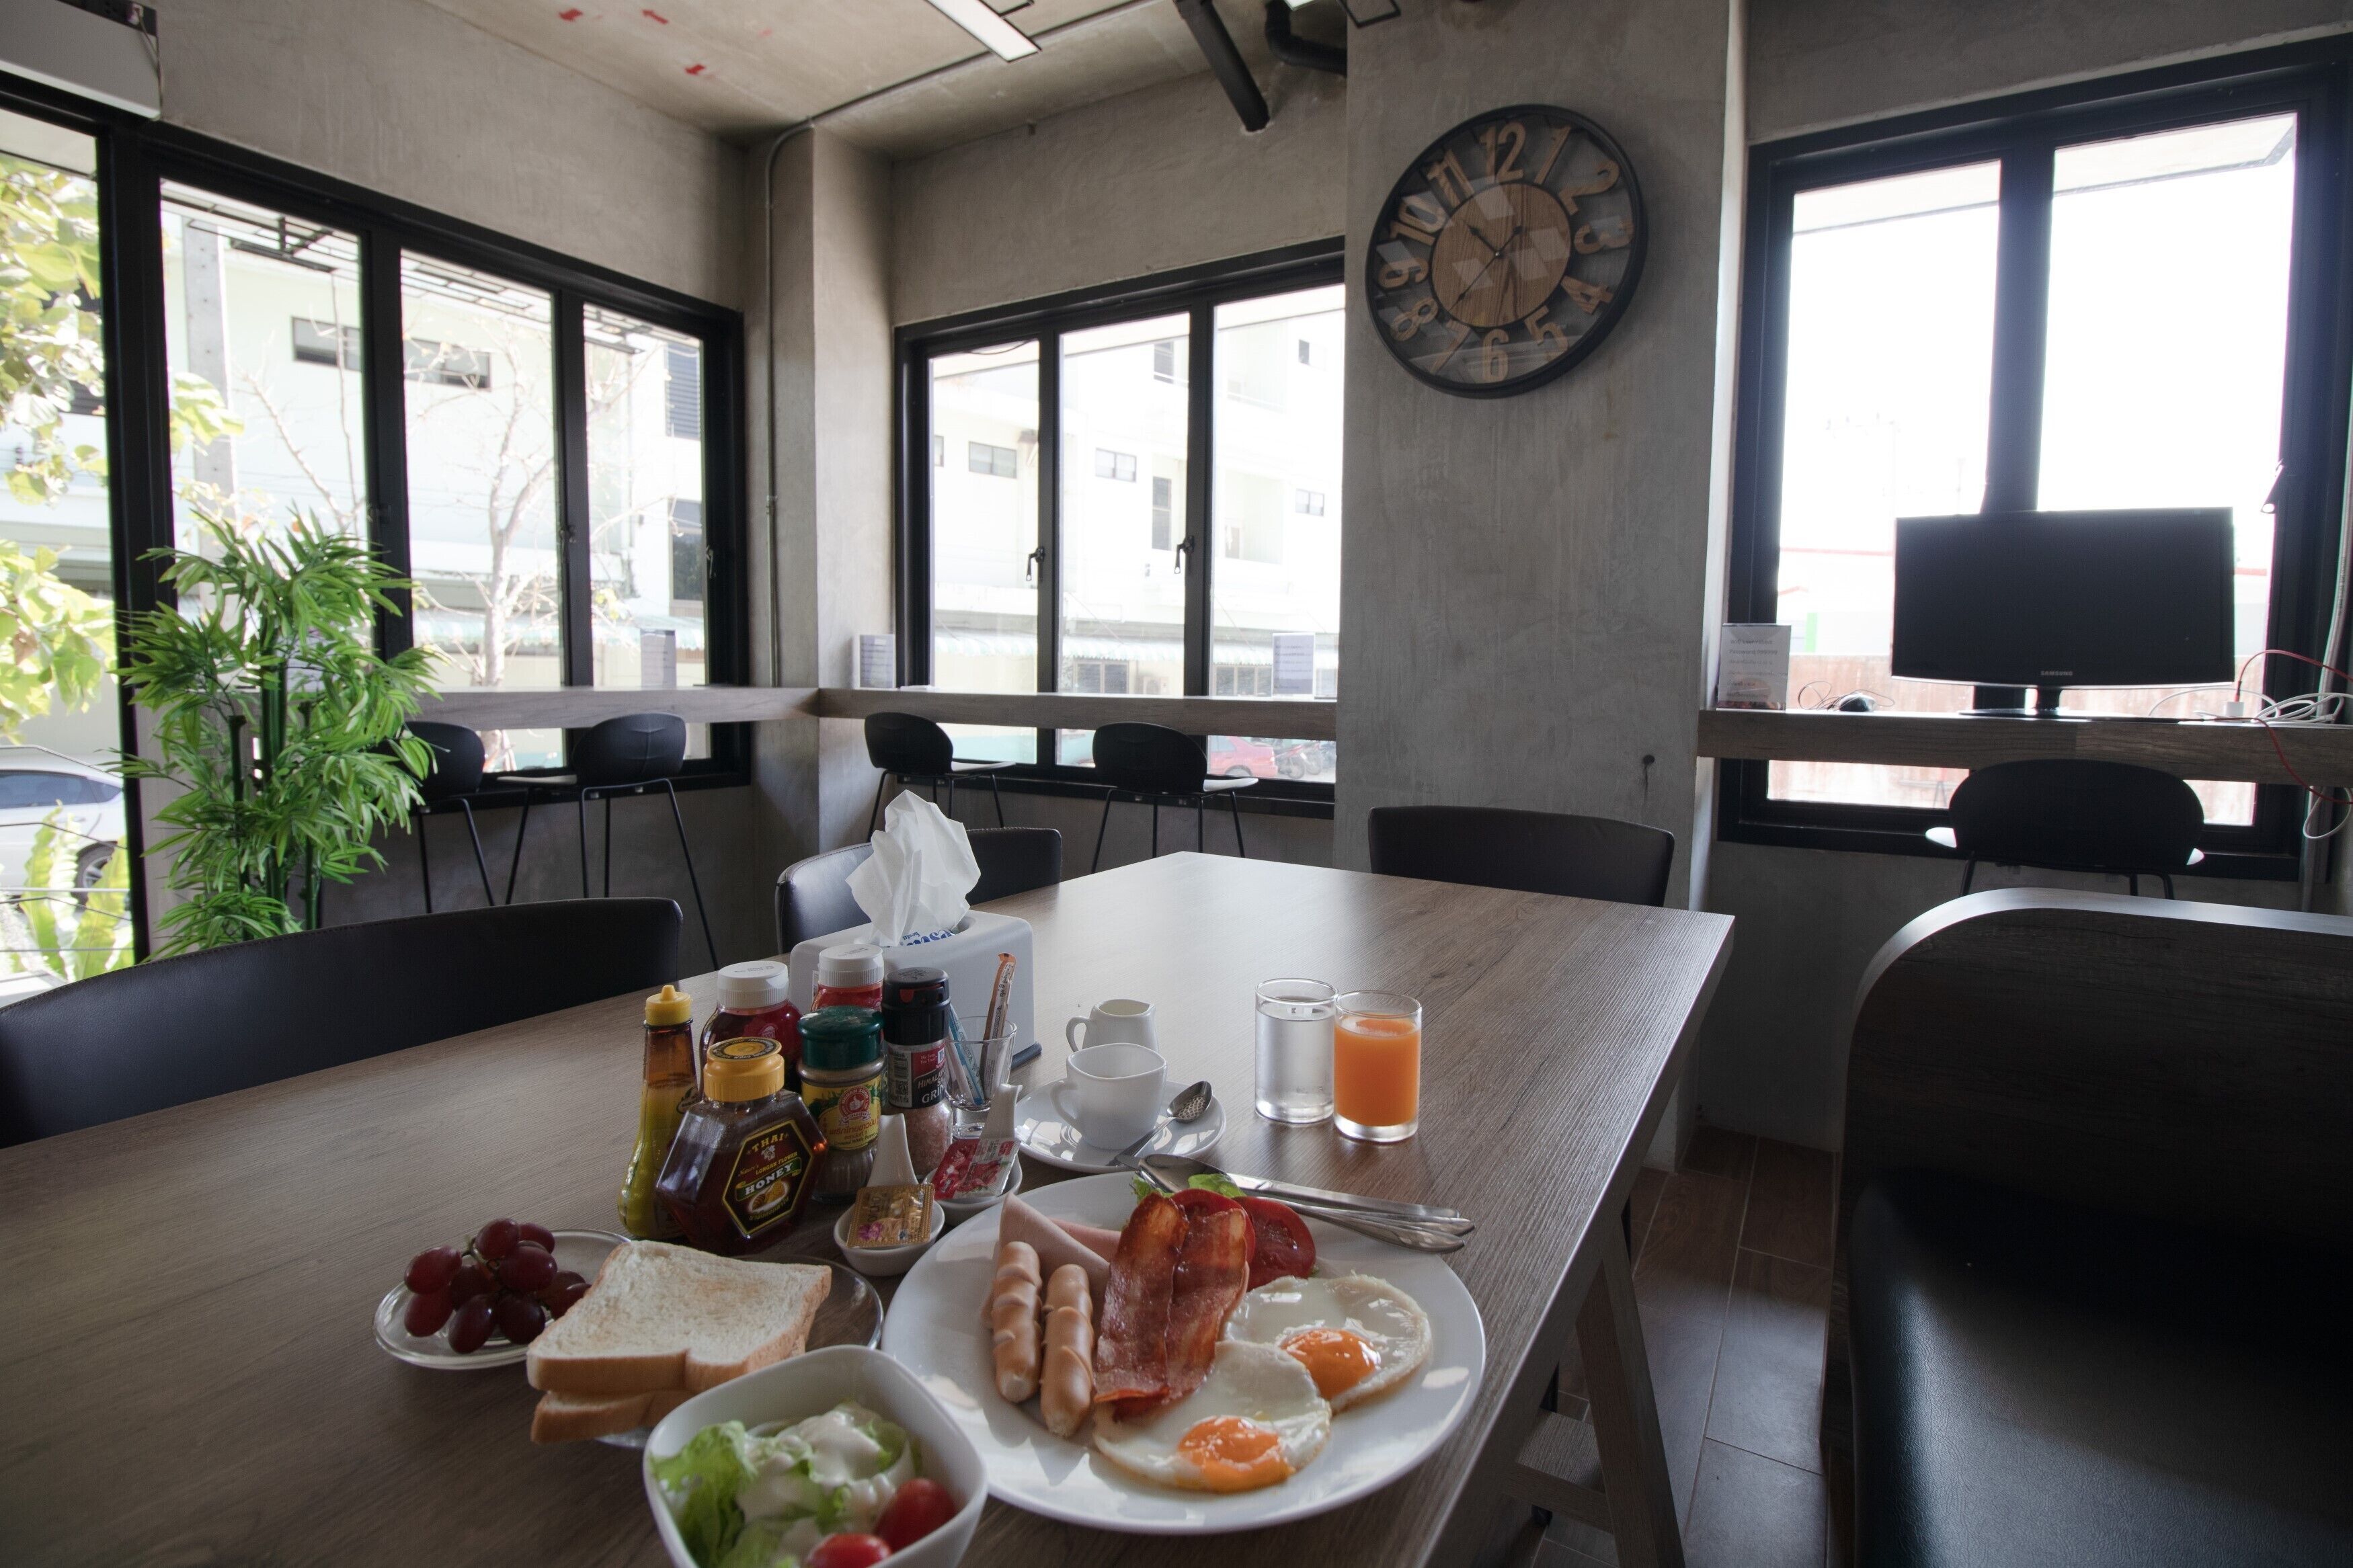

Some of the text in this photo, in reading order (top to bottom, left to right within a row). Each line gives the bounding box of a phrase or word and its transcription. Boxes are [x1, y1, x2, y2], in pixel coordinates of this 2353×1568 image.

[1479, 121, 1527, 183] 12
[1536, 124, 1572, 185] 1
[1426, 149, 1475, 208] 11
[1558, 159, 1620, 216] 2
[1389, 196, 1447, 247] 10
[1573, 218, 1634, 255] 3
[1378, 255, 1429, 289] 9
[1561, 274, 1614, 316] 4
[1390, 296, 1439, 342] 8
[1523, 304, 1570, 364] 5
[1429, 318, 1474, 375] 7
[1482, 328, 1510, 383] 6
[752, 1132, 784, 1152] THAI
[756, 1151, 798, 1175] LONGAN FLOWER
[744, 1162, 793, 1196] HONEY
